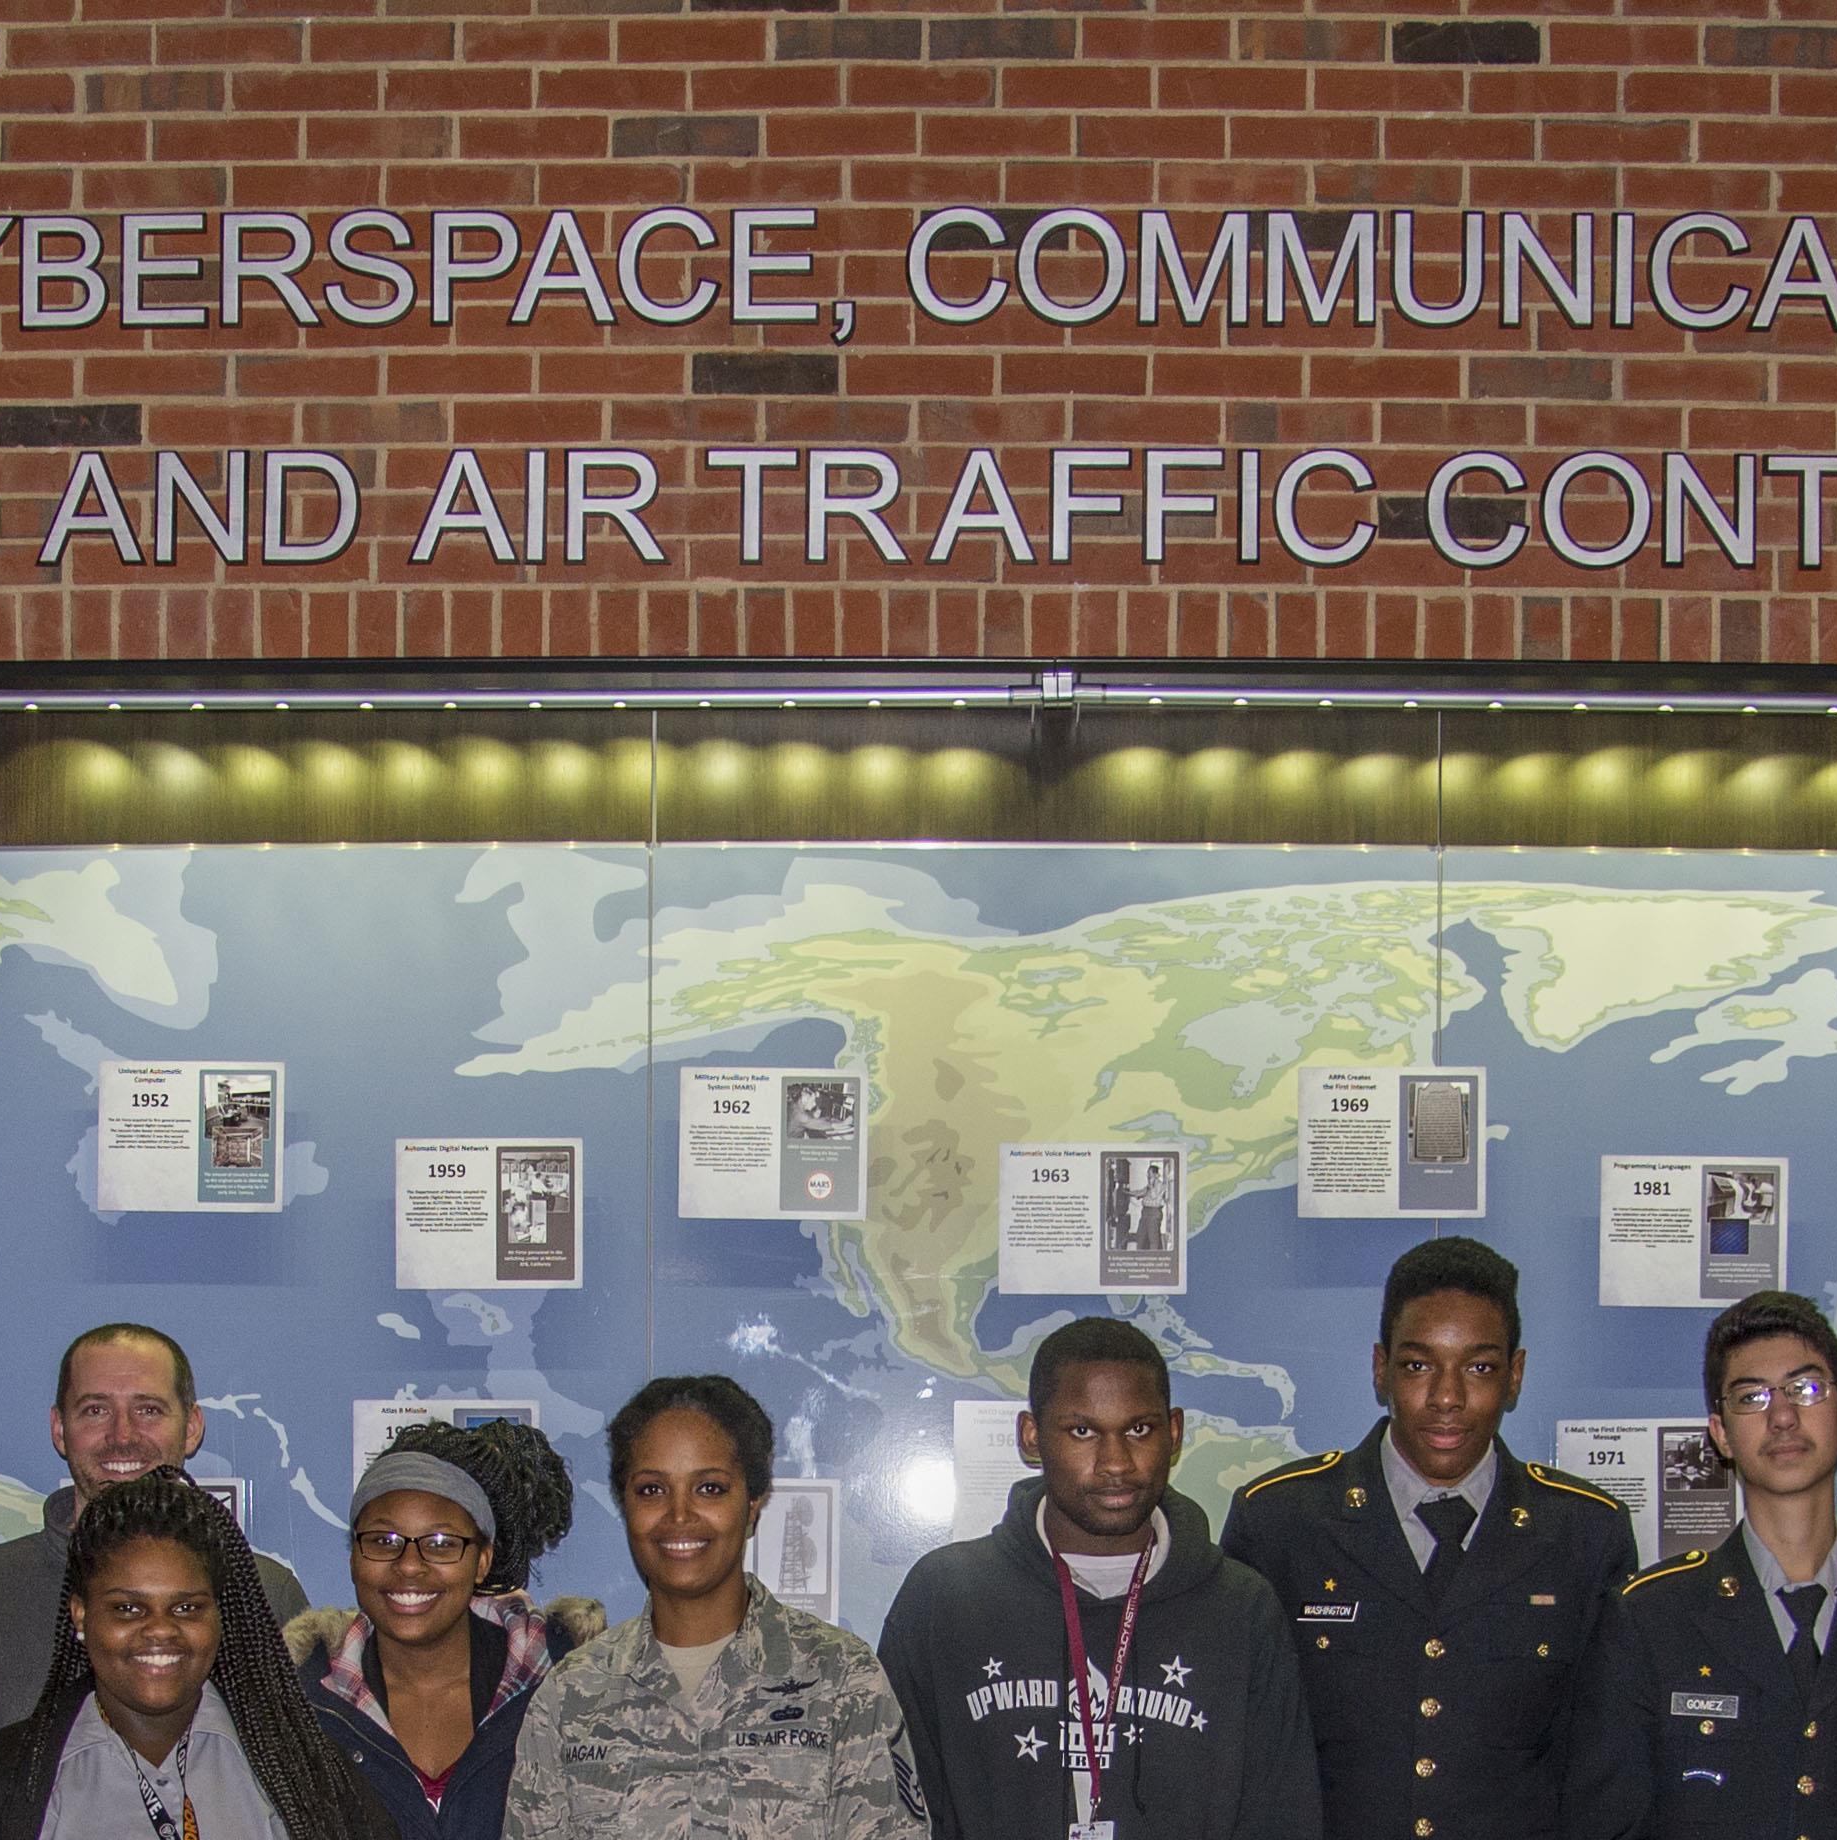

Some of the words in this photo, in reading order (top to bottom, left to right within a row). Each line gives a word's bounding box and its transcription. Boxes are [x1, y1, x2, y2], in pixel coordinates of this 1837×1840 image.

[40, 450, 360, 568] AND
[410, 448, 668, 565] AIR
[705, 447, 1377, 566] TRAFFIC
[694, 1074, 719, 1082] Military
[707, 1084, 730, 1092] System
[731, 1084, 757, 1092] (MARS)
[131, 1093, 169, 1108] 1952
[712, 1100, 751, 1114] 1962
[1330, 1098, 1369, 1112] 1969
[439, 1145, 460, 1153] Digital
[428, 1163, 466, 1178] 1959
[1613, 1162, 1657, 1170] Programming
[1031, 1168, 1070, 1183] 1963
[1633, 1181, 1671, 1196] 1981
[1564, 1426, 1587, 1434] E-Mail,
[1587, 1451, 1626, 1465] 1971
[1304, 1605, 1352, 1616] WASHINGTON
[966, 1680, 1058, 1721] UPWARD
[1116, 1686, 1193, 1727] BOUND
[1686, 1699, 1723, 1711] GOMEZ
[764, 1730, 787, 1746] AIR
[790, 1729, 828, 1748] FORCE
